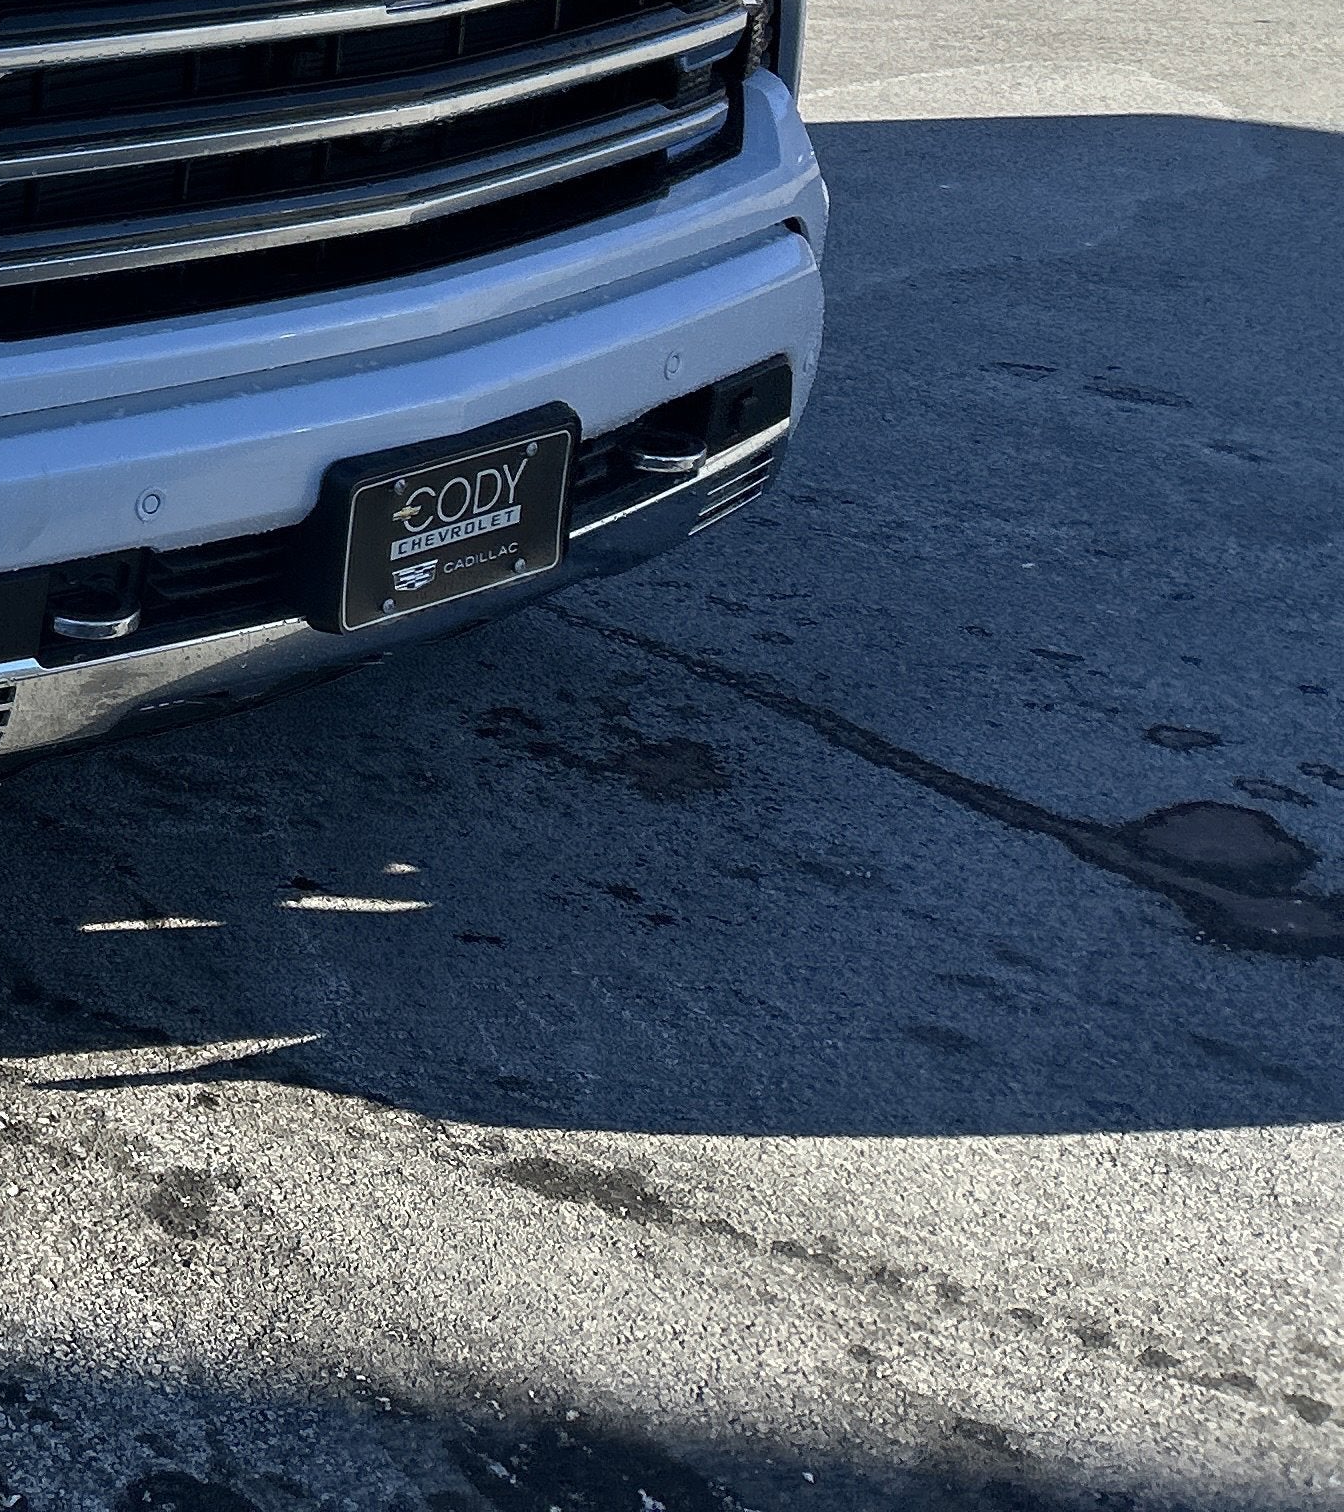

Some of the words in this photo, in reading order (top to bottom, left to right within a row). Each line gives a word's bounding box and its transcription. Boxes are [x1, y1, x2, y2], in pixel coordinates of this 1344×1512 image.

[403, 458, 528, 532] CODY
[397, 509, 515, 556] CHEVROLET
[443, 542, 519, 575] CADILLAC
